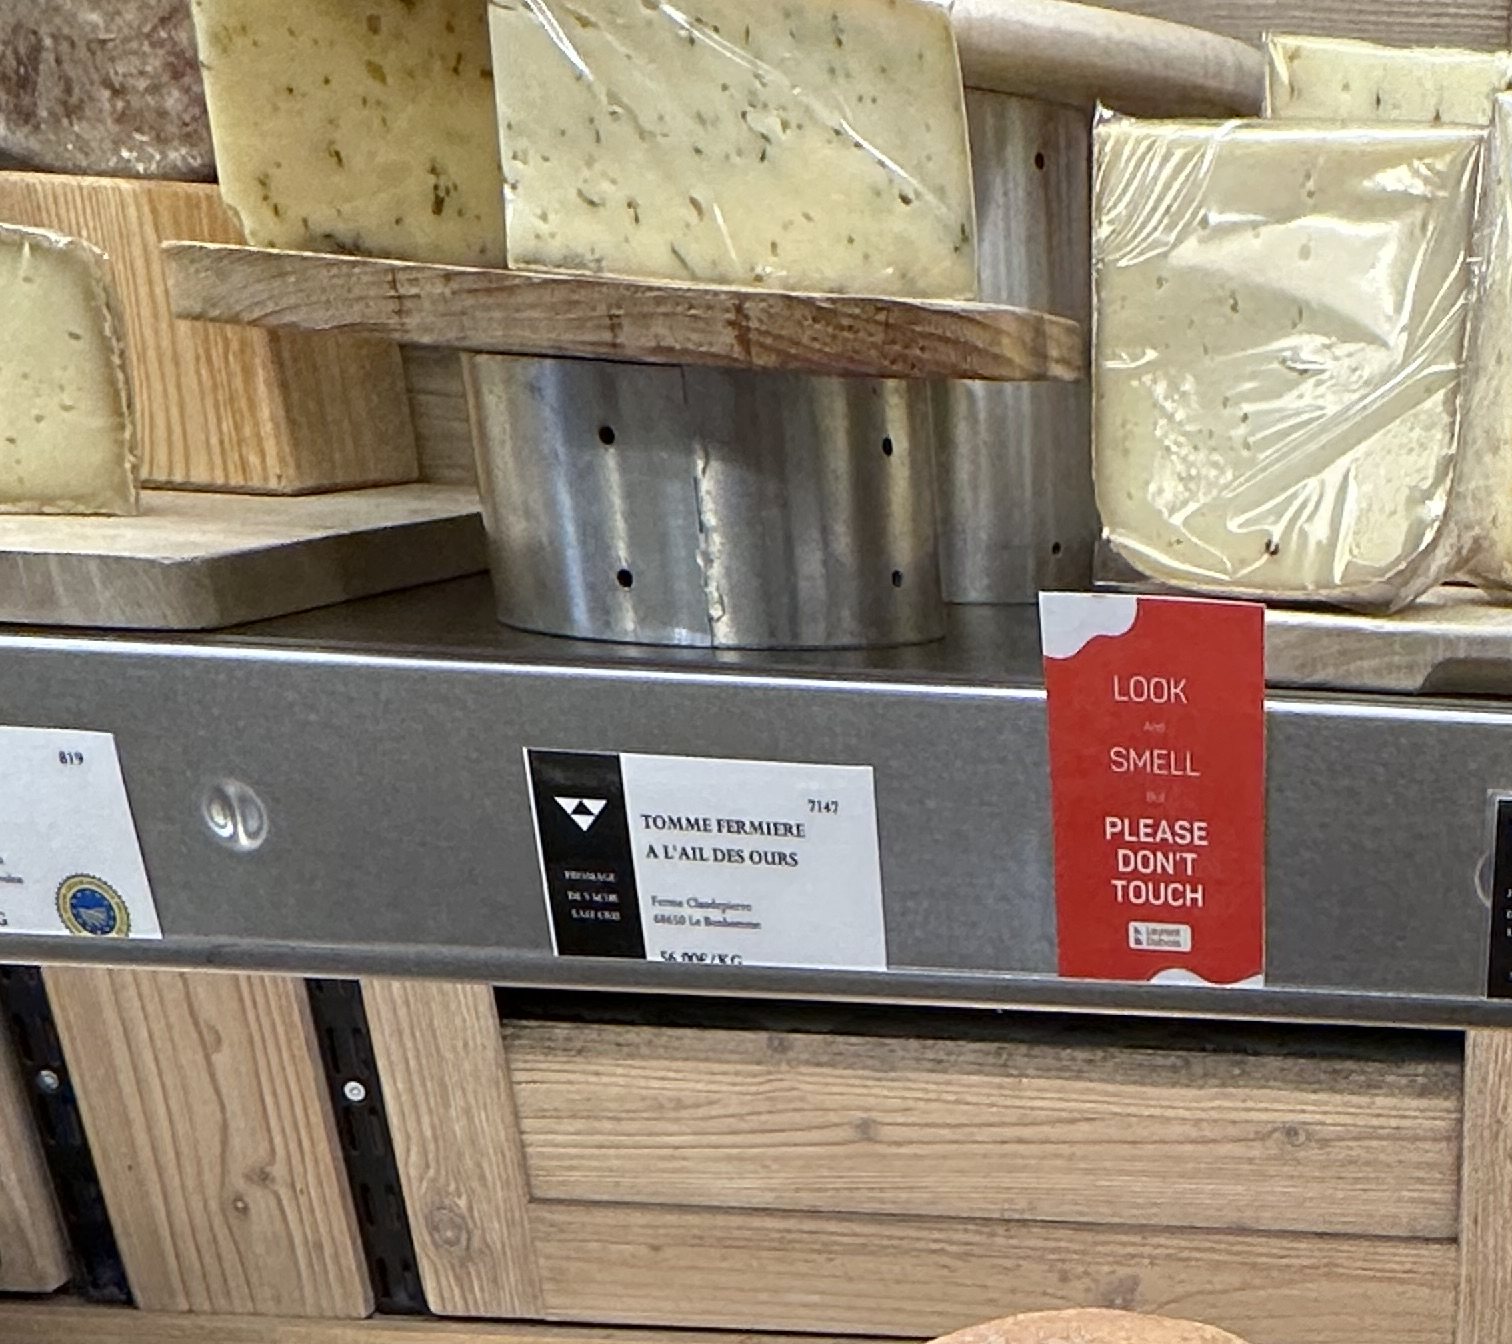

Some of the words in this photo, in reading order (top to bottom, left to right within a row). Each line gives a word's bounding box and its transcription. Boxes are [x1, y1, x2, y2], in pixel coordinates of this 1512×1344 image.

[1113, 675, 1188, 704] LOOK
[1109, 746, 1201, 777] SMELL
[808, 799, 839, 816] 7147
[640, 814, 712, 834] TOMME
[716, 818, 806, 839] FERMIERE
[1104, 815, 1209, 846] PLEASE
[646, 844, 660, 859] A
[663, 844, 709, 863] L'AIL
[713, 848, 745, 865] DES
[749, 850, 799, 868] OURS
[1117, 848, 1198, 876] DON'T
[1112, 879, 1204, 908] TOUCH
[660, 950, 744, 966] 5600€/KG
